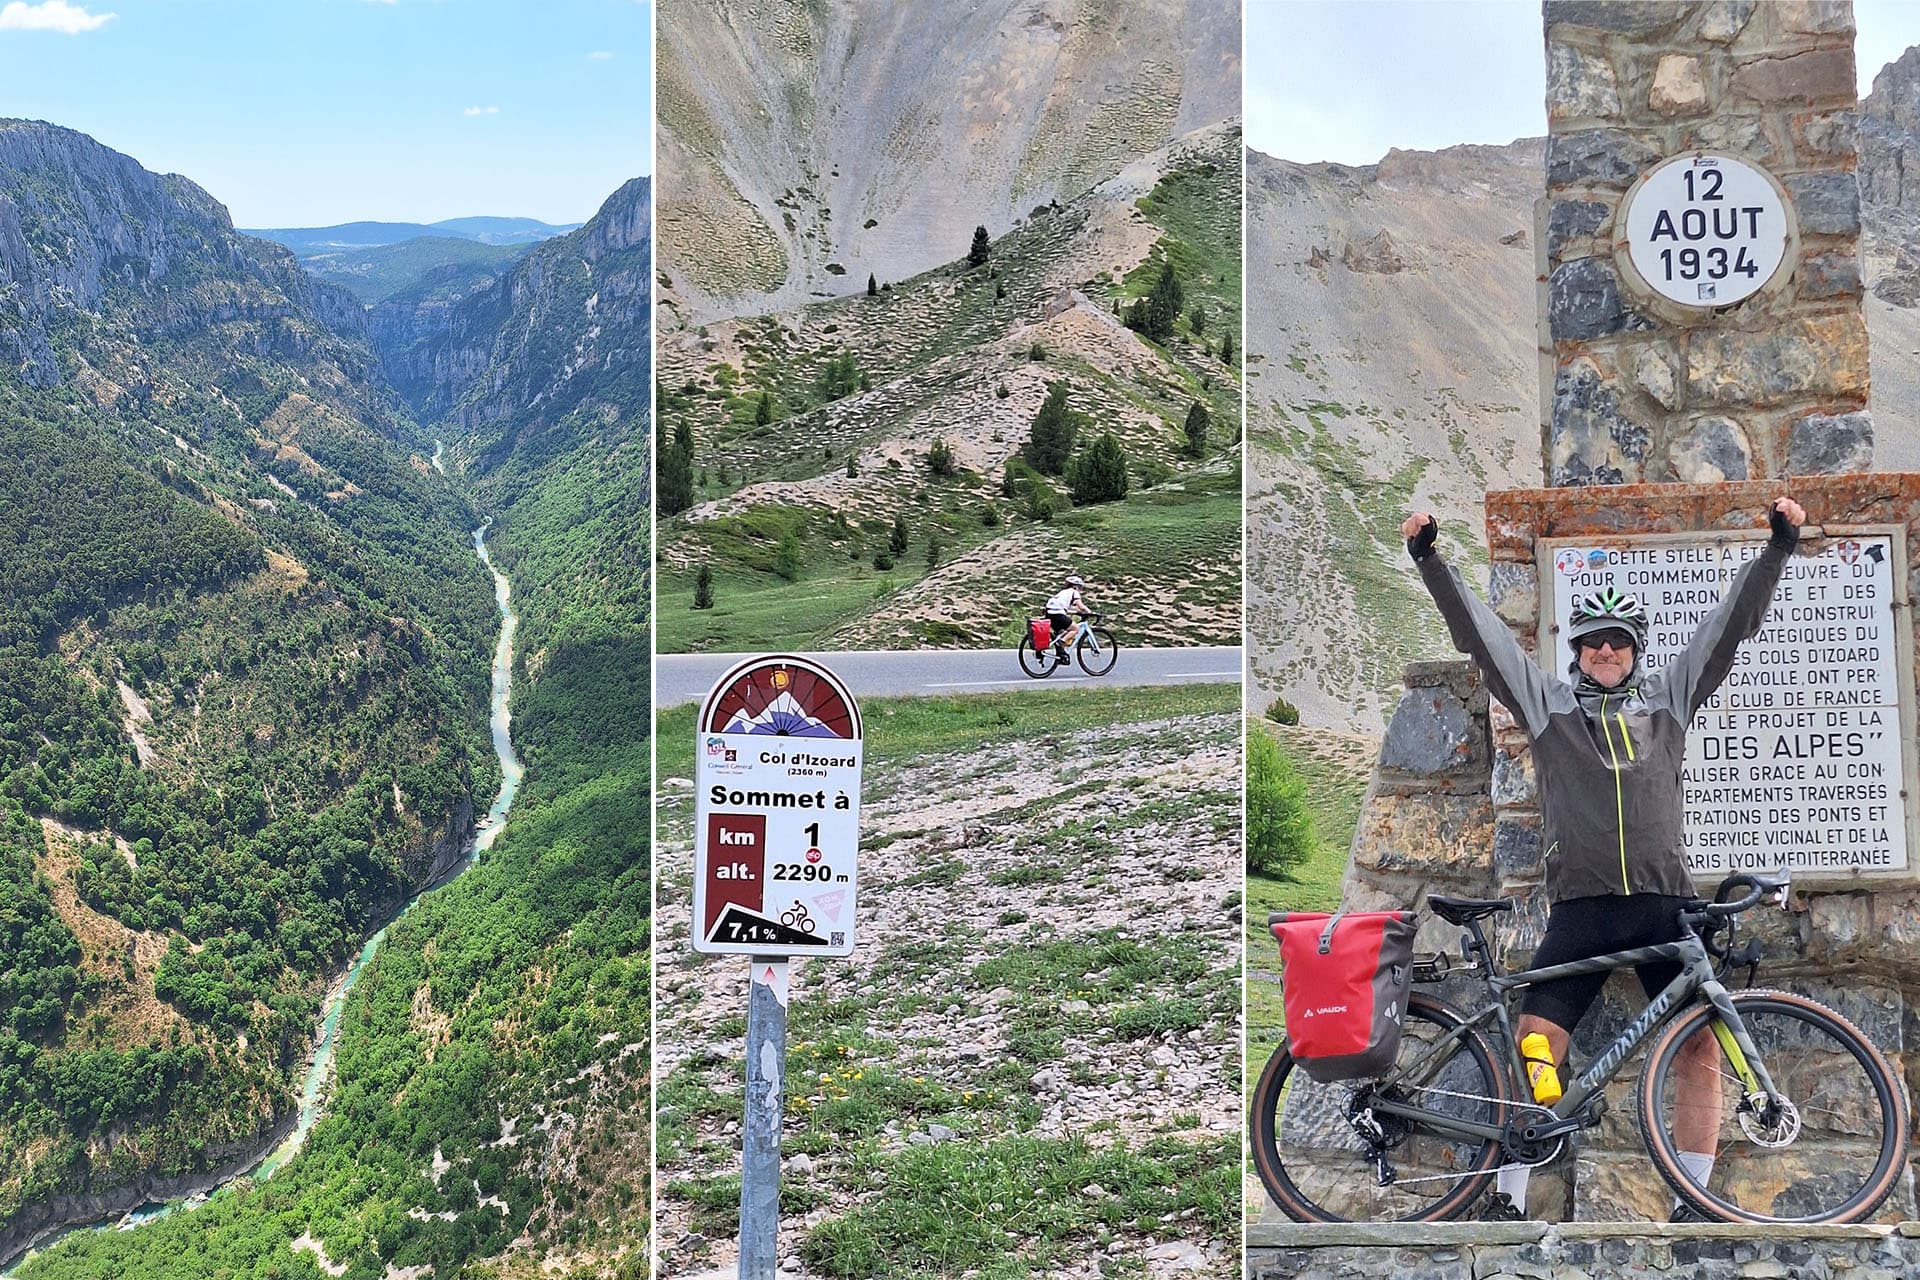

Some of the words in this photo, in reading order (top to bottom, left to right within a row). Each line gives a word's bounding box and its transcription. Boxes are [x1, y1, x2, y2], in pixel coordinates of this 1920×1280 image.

[1684, 169, 1724, 202] 12
[1650, 207, 1763, 242] AOUT
[1660, 246, 1759, 281] 1934
[1608, 550, 1657, 566] CETTE
[1666, 549, 1713, 564] STELE
[1722, 548, 1733, 561] A
[1570, 571, 1615, 587] POUR
[1628, 566, 1738, 585] COMMÉMORE
[1852, 563, 1875, 578] DU
[1663, 589, 1720, 606] BARON
[1808, 585, 1827, 600] ET
[1843, 584, 1876, 599] DES
[1856, 626, 1878, 641] DU
[1759, 650, 1800, 665] COLS
[1808, 648, 1880, 663] D'IZOARD
[1807, 669, 1839, 684] ONT
[1730, 692, 1774, 708] CLUB
[1784, 691, 1805, 706] DE
[1814, 689, 1882, 705] FRANCE
[1719, 714, 1737, 729] LE
[1747, 712, 1815, 729] PROJET
[1826, 711, 1849, 727] DE
[1859, 711, 1882, 726] LA
[1703, 736, 1758, 760] DES
[759, 752, 786, 764] Col
[791, 753, 856, 768] d'Izoard
[1682, 767, 1740, 782] ALISER
[1750, 765, 1806, 781] GRACE
[1814, 764, 1837, 779] AU
[710, 785, 826, 809] Sommet
[834, 790, 850, 810] à
[1686, 786, 1793, 804] ÉPARTEMENTS
[1799, 782, 1887, 801] TRAVERSÉS
[1769, 808, 1800, 823] DES
[1808, 806, 1861, 822] PONTS
[1869, 806, 1887, 821] ET
[719, 827, 755, 846] km
[804, 822, 819, 847] 1
[1699, 831, 1760, 847] SERVICE
[1765, 829, 1822, 845] VICINAL
[1827, 829, 1843, 843] ET
[1849, 828, 1867, 843] DE
[1872, 828, 1889, 842] LA
[716, 862, 756, 880] alt.
[773, 863, 832, 882] 2290
[836, 874, 849, 883] m
[728, 922, 758, 942] 7,1
[763, 927, 777, 941] %
[1316, 1005, 1348, 1015] VAUDE
[1581, 993, 1670, 1092] SPECIALIZED
